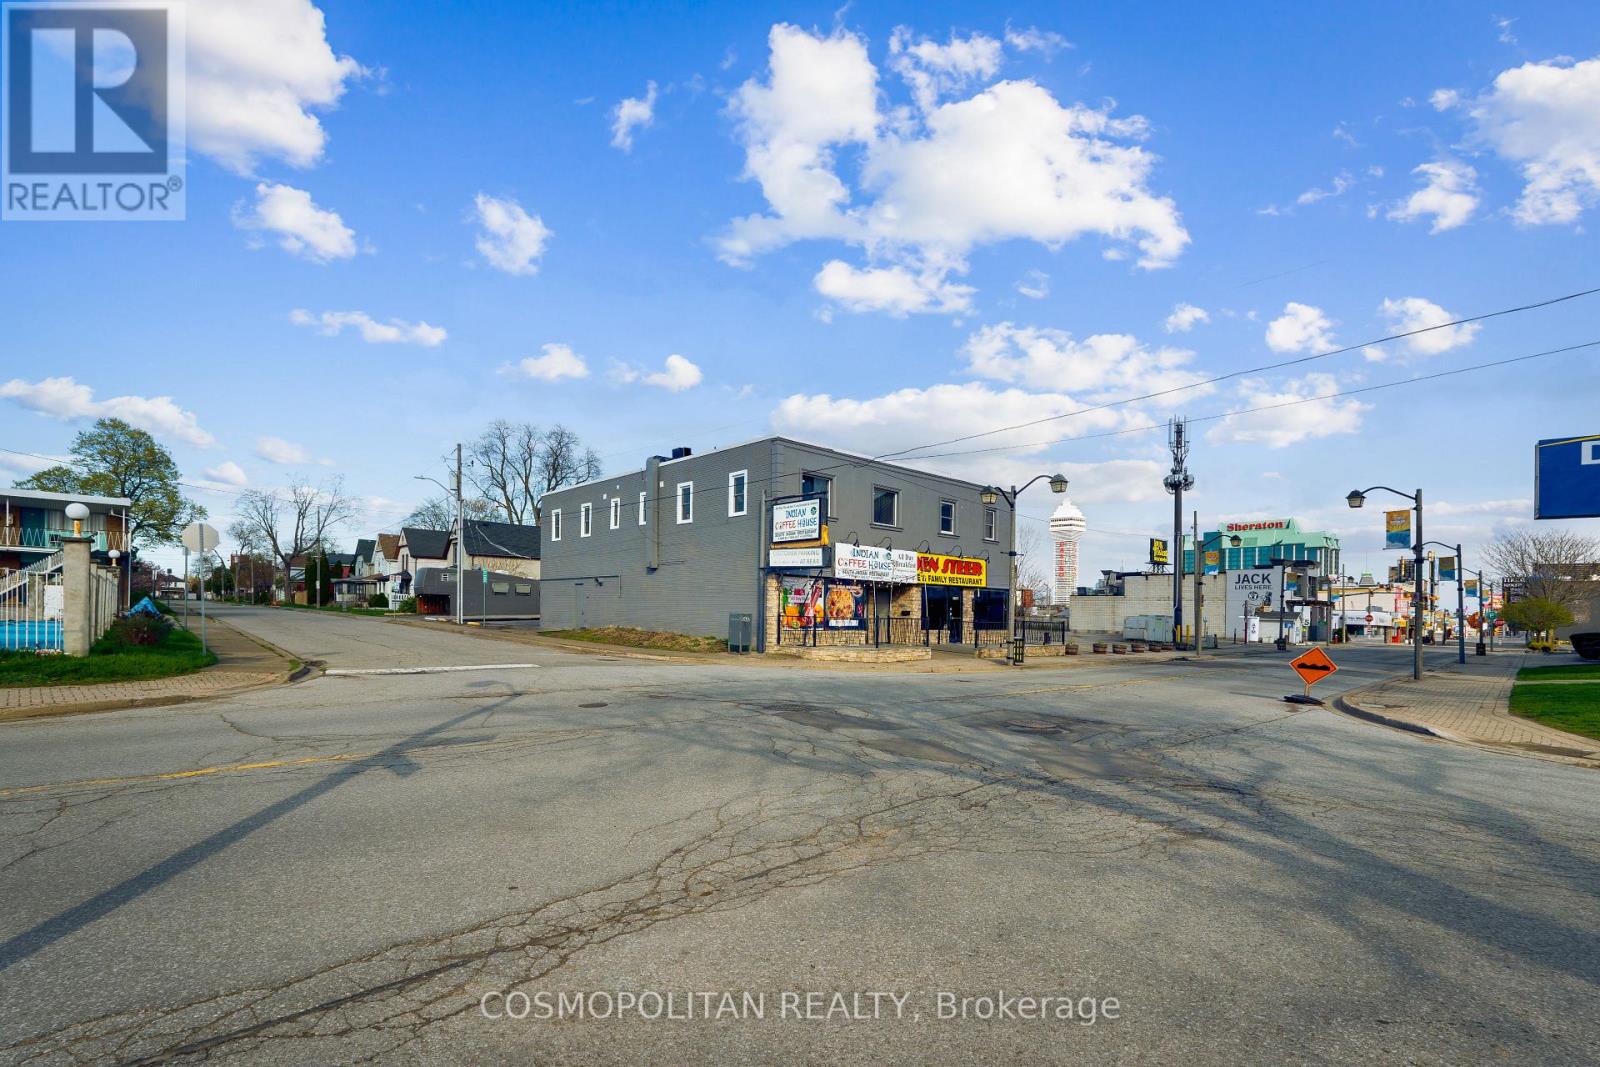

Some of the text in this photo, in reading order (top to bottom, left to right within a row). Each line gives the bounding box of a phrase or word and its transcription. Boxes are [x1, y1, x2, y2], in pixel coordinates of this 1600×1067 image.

[785, 508, 806, 518] INDIAN
[775, 518, 817, 530] COFFEE HOUSE
[1227, 522, 1283, 531] Sheraton
[852, 548, 879, 560] INDIAN
[837, 558, 892, 571] COFFEE HOUSE
[941, 558, 983, 576] STEER
[928, 575, 947, 583] FAMILY
[948, 576, 983, 585] RESTAURANT
[1235, 574, 1271, 584] JACK
